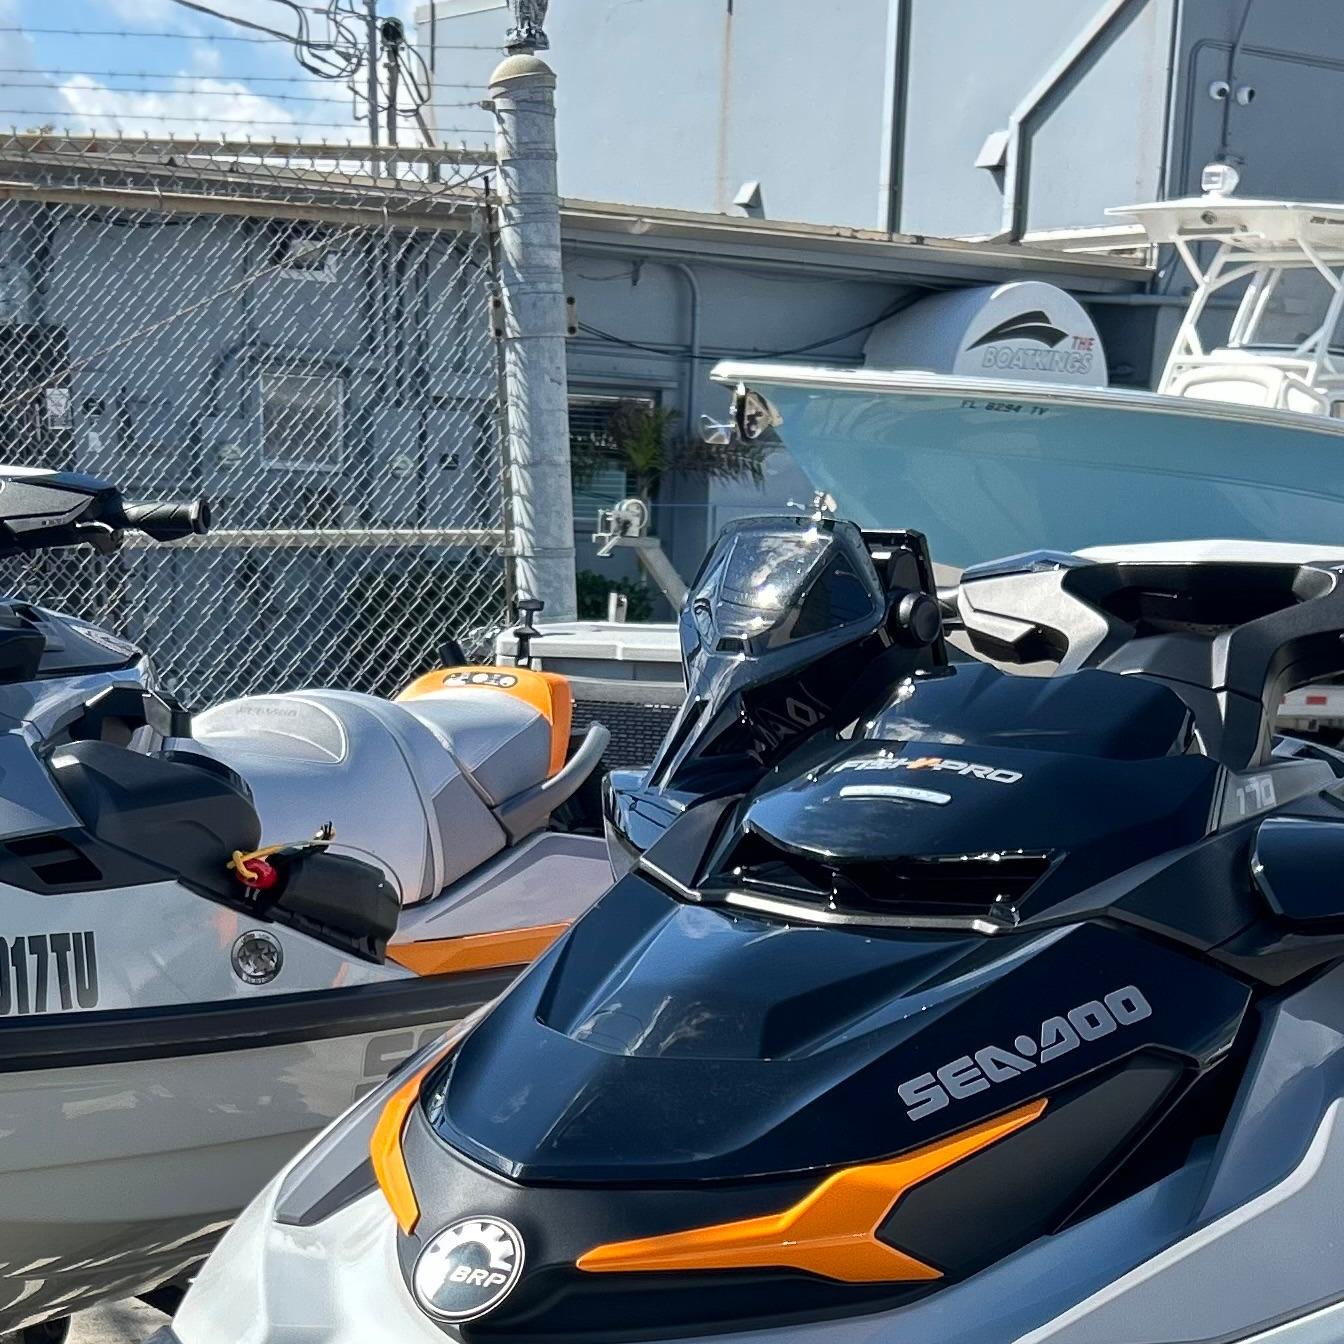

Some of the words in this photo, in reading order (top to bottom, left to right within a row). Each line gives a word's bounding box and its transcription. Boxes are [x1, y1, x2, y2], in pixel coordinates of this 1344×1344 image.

[1071, 336, 1096, 351] THE
[1236, 774, 1277, 815] 170
[449, 1265, 507, 1288] BRP
